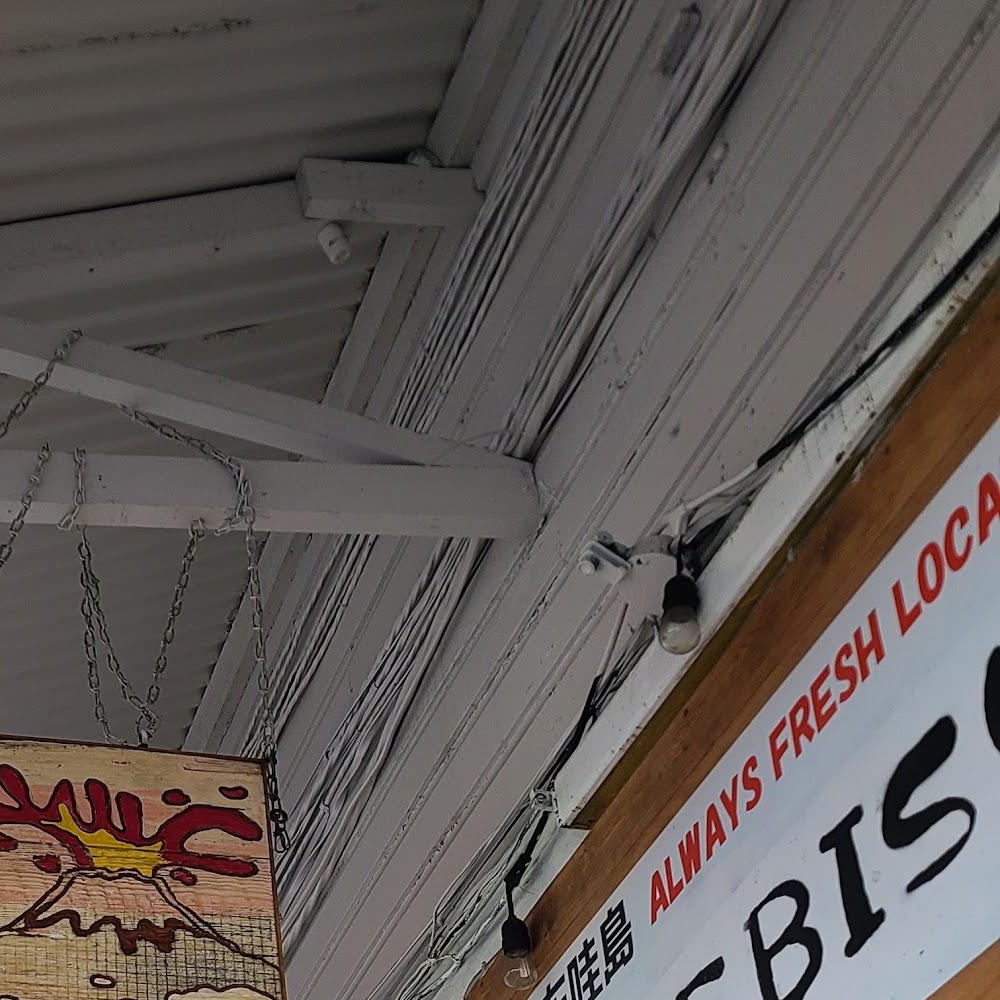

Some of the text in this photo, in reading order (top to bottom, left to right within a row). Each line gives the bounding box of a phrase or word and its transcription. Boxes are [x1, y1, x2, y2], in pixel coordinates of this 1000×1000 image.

[651, 473, 1000, 922] ALWAYS FRESH LOCA
